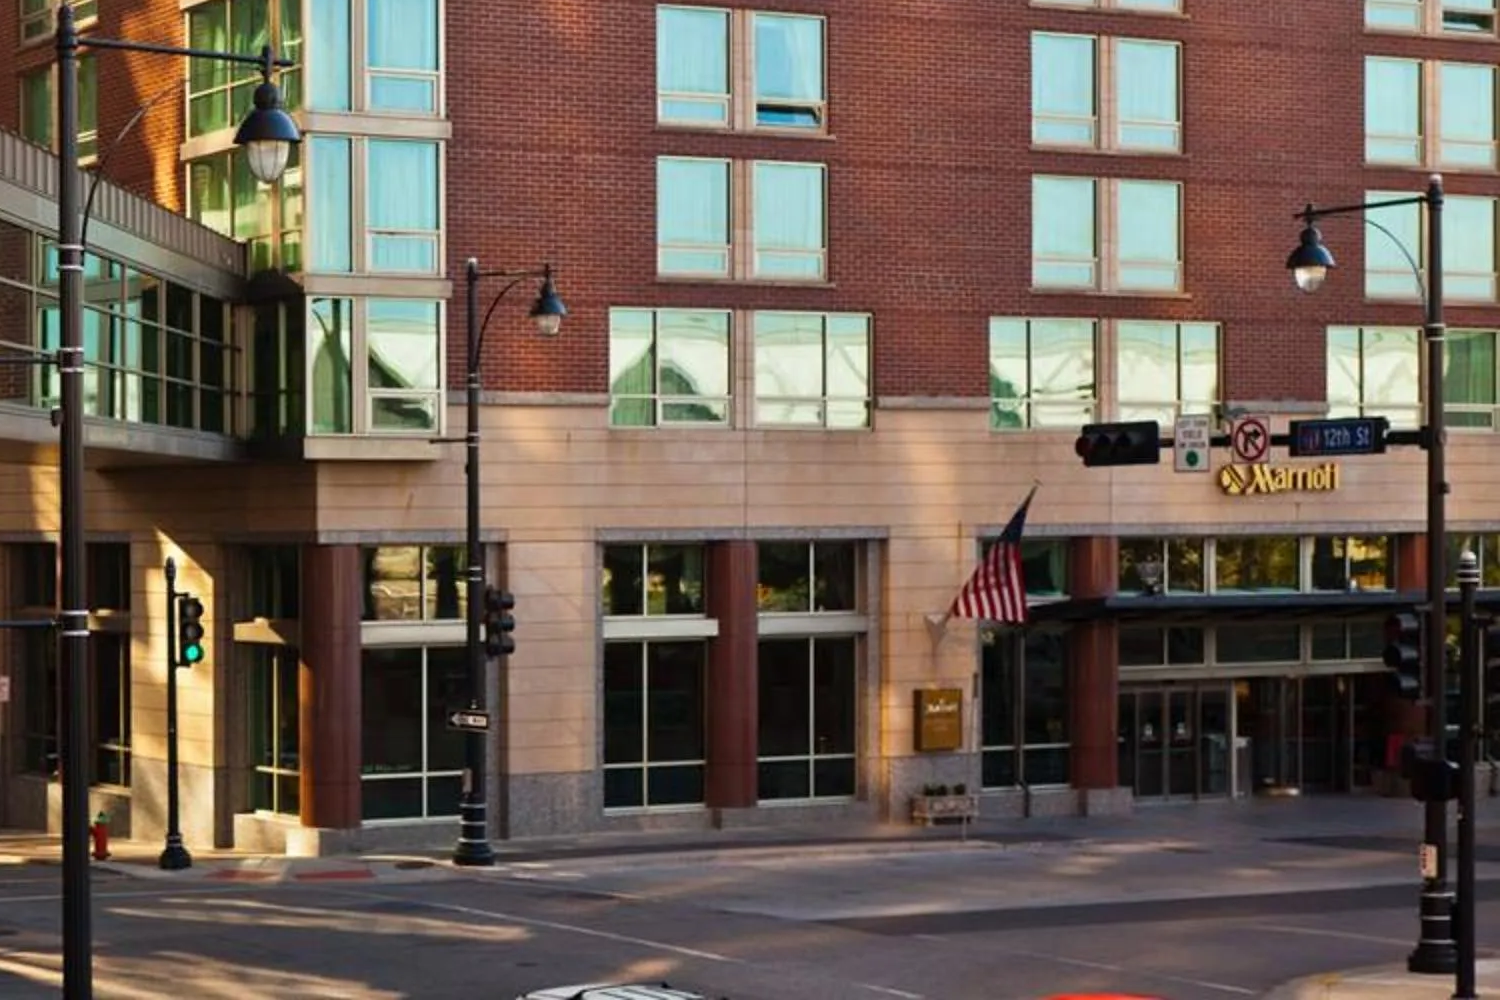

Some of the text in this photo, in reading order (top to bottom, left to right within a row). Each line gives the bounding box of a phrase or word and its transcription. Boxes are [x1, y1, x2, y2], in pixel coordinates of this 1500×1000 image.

[1323, 426, 1370, 448] 12th St
[1246, 462, 1340, 495] Marriott
